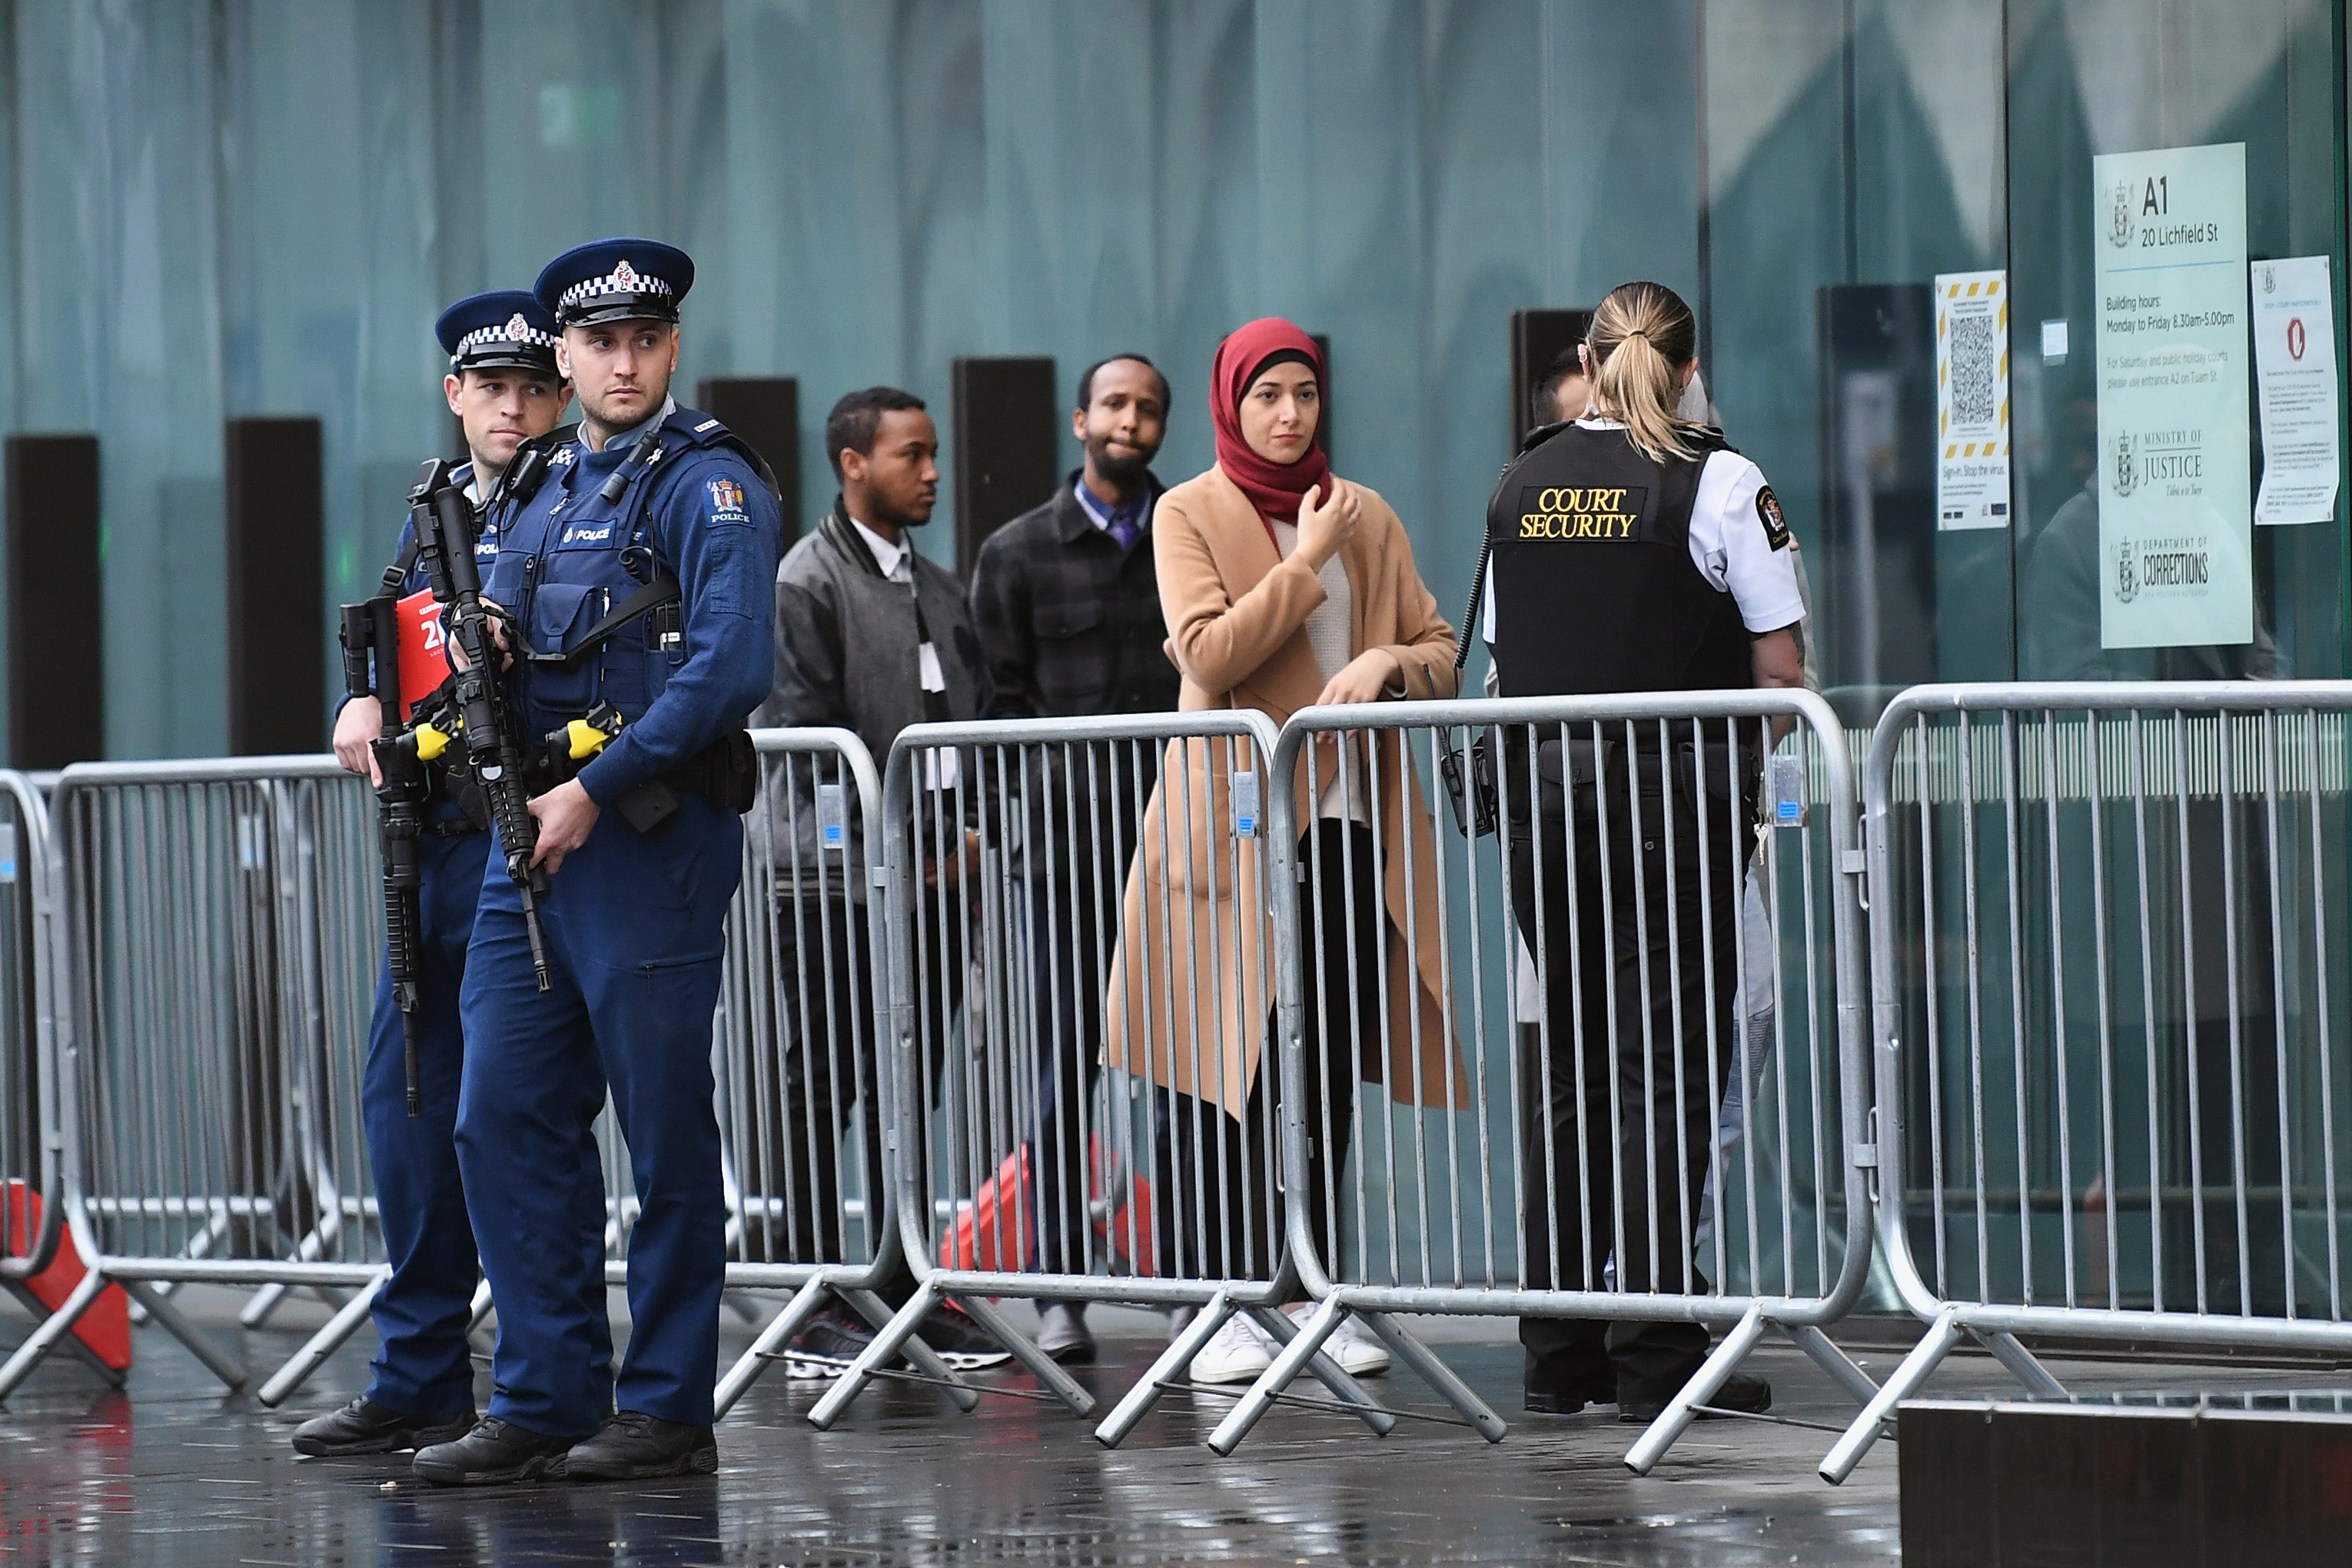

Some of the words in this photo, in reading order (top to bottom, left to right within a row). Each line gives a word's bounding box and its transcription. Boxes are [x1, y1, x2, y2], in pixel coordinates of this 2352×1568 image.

[2142, 175, 2168, 217] A1
[2142, 228, 2156, 247] 20
[2159, 223, 2204, 246] Lichfield
[2207, 223, 2218, 242] St
[2106, 296, 2136, 312] Building
[2138, 294, 2161, 308] hours:
[2107, 317, 2136, 334] Monday
[2138, 318, 2146, 331] to
[2148, 315, 2171, 332] Friday
[2173, 311, 2234, 329] 8.30am-5.00pm
[2107, 357, 2118, 368] For
[2120, 355, 2148, 369] Saturday
[2149, 354, 2161, 366] and
[2163, 352, 2181, 367] public
[2184, 351, 2207, 365] holiday
[2207, 350, 2228, 362] courts
[2141, 374, 2169, 387] entrance
[2171, 373, 2180, 384] A2
[2181, 375, 2190, 384] on
[2191, 371, 2208, 383] Tuam
[2144, 430, 2188, 445] MINISTRY
[2191, 430, 2201, 442] OF
[2144, 455, 2203, 486] JUSTICE
[1539, 488, 1627, 513] COURT
[711, 513, 750, 523] POLICE
[1520, 513, 1637, 539] SECURITY
[576, 528, 610, 540] POLICE
[2144, 537, 2194, 550] DEPARTMENT
[2198, 537, 2207, 548] OF
[477, 543, 500, 556] POL
[2143, 552, 2208, 586] CORRECTIONS
